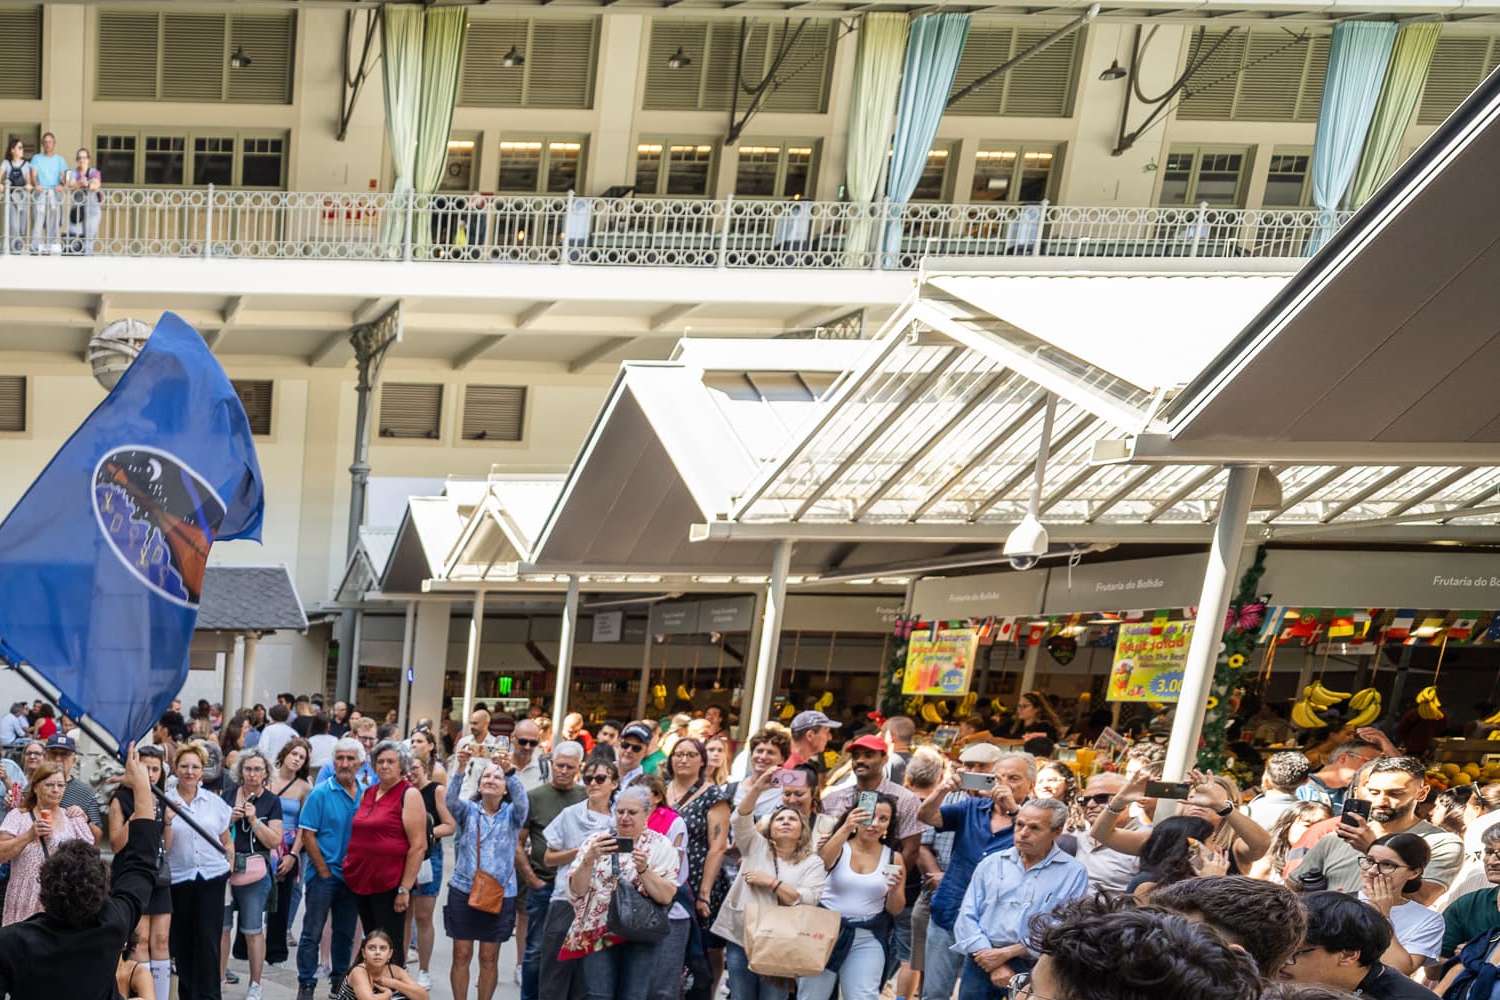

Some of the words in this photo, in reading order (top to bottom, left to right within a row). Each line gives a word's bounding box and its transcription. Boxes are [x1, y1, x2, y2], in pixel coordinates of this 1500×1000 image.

[1095, 582, 1125, 593] Frutaria
[1125, 581, 1136, 591] do
[1431, 575, 1473, 588] Frutaria
[1474, 576, 1488, 588] do
